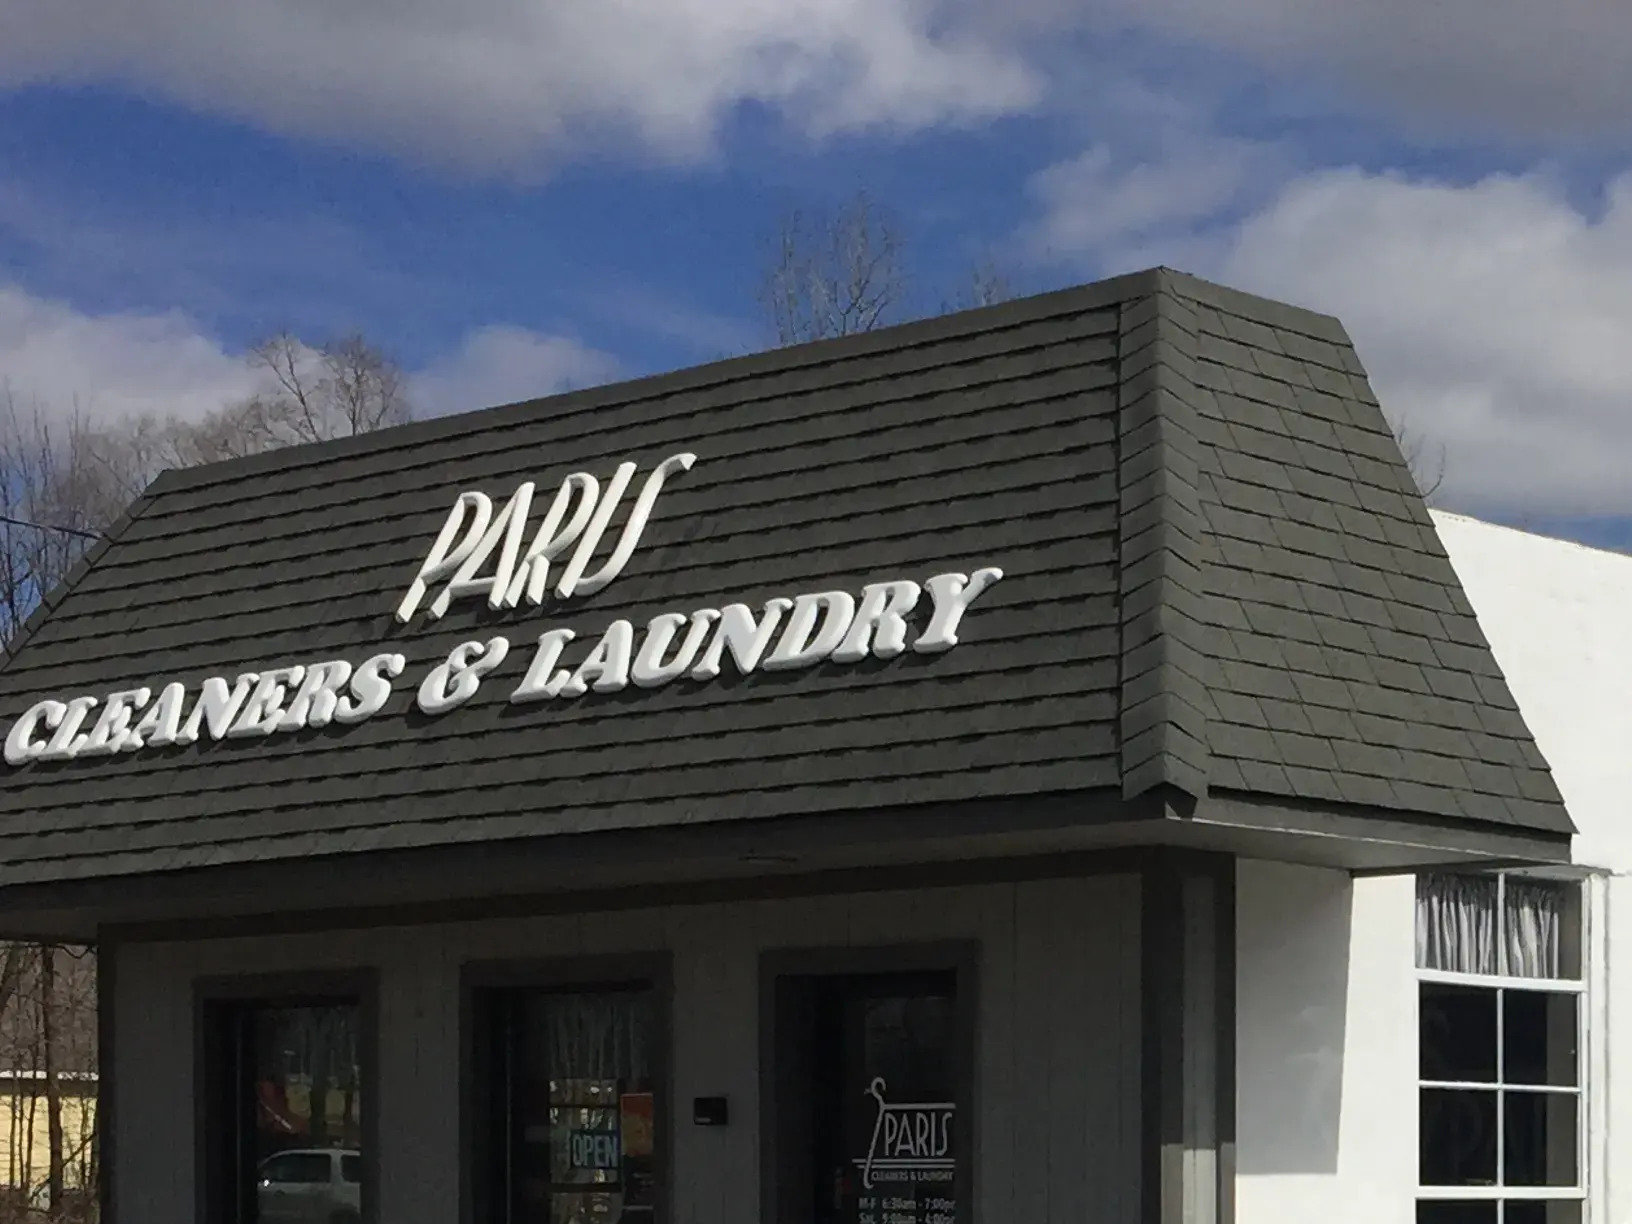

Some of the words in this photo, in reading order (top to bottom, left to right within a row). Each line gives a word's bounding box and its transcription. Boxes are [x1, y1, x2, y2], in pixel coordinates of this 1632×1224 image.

[396, 452, 697, 623] PARIS
[3, 652, 405, 766] CLEANERS
[416, 636, 509, 715] &
[510, 566, 1003, 706] LAUNDRY
[572, 1133, 618, 1168] OPEN
[884, 1111, 953, 1157] PARIS
